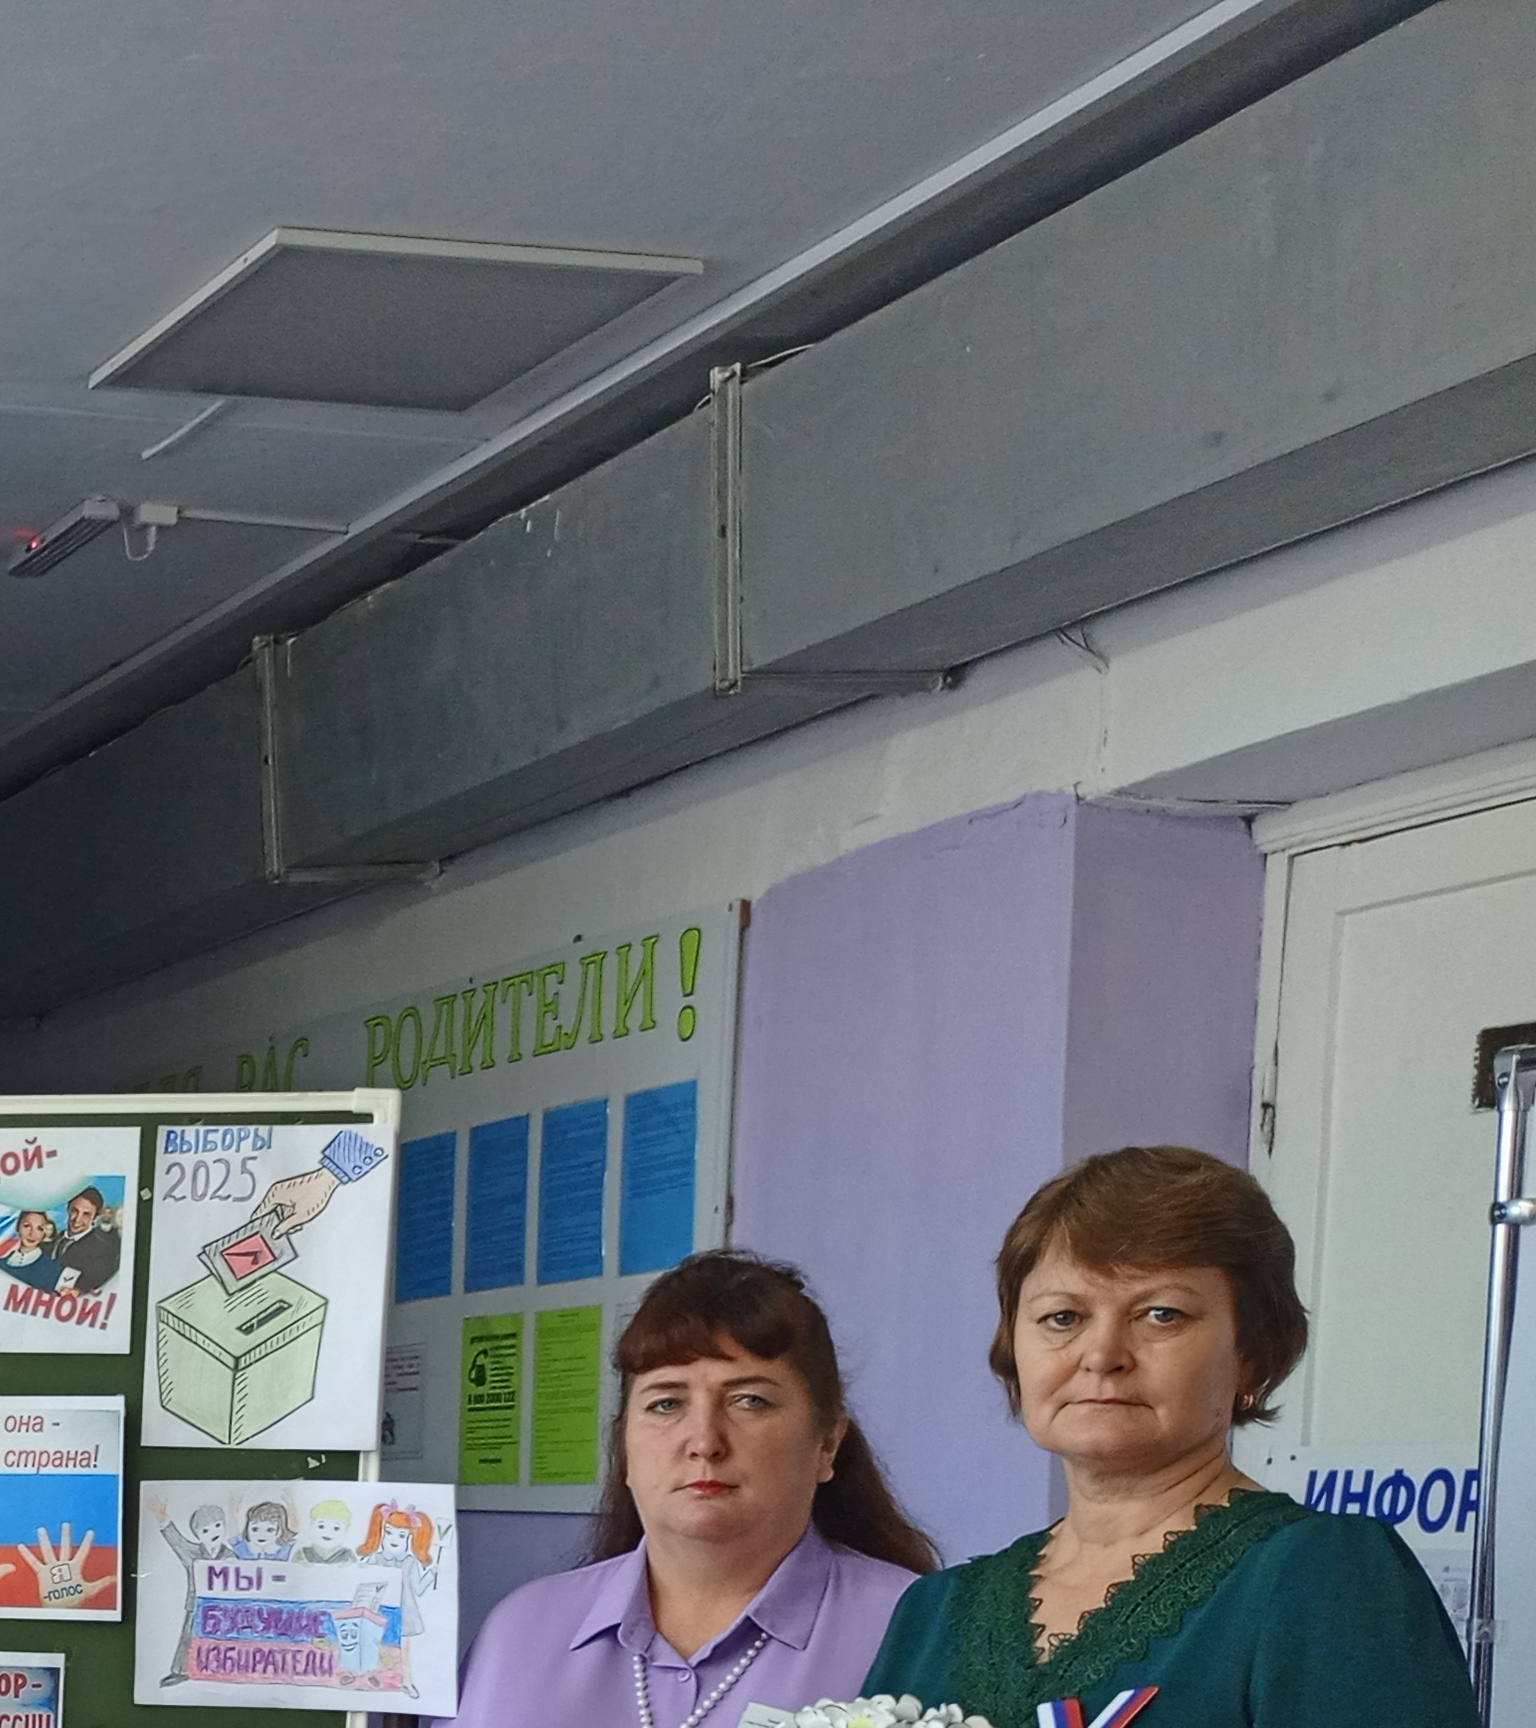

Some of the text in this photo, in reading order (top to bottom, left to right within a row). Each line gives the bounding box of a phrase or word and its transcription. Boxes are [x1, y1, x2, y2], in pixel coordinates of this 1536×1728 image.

[363, 927, 702, 1090] РОДИТЕЛИ!
[162, 1125, 274, 1156] ВЫБОРЫ
[162, 1155, 261, 1203] 2025
[3, 1282, 119, 1332] мной!
[3, 1414, 46, 1434] она
[3, 1444, 101, 1475] страна!
[50, 1562, 74, 1585] Я
[207, 1565, 264, 1592] МЫ
[195, 1644, 336, 1678] ИЗБИРАТЕЛИ
